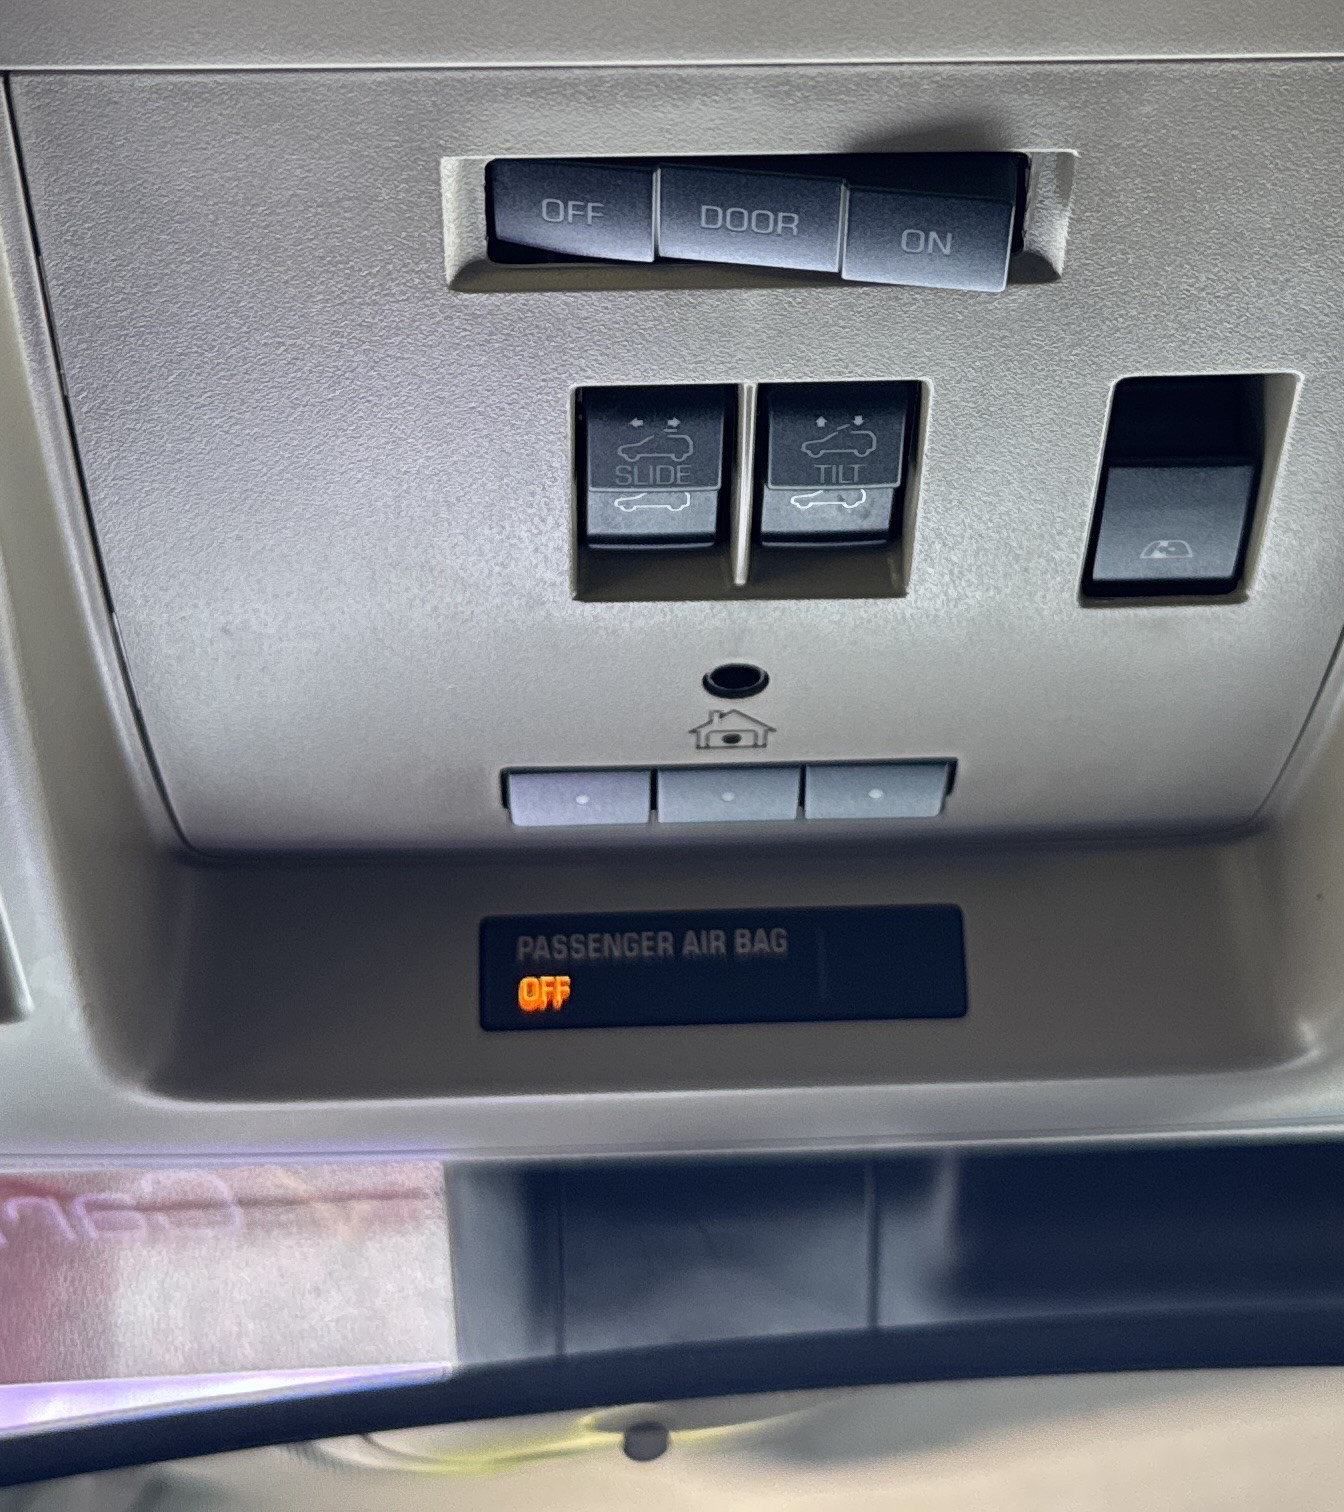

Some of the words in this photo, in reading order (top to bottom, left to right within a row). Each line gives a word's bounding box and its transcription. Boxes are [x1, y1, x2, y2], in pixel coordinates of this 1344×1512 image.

[540, 197, 605, 226] OFF
[699, 204, 800, 237] DOOR
[899, 228, 954, 257] ON
[615, 463, 691, 486] SLIDE
[814, 463, 864, 485] TILT
[517, 930, 675, 960] PASSENGER
[682, 928, 727, 956] AIR
[734, 926, 788, 955] BAG
[517, 974, 571, 1011] OFF
